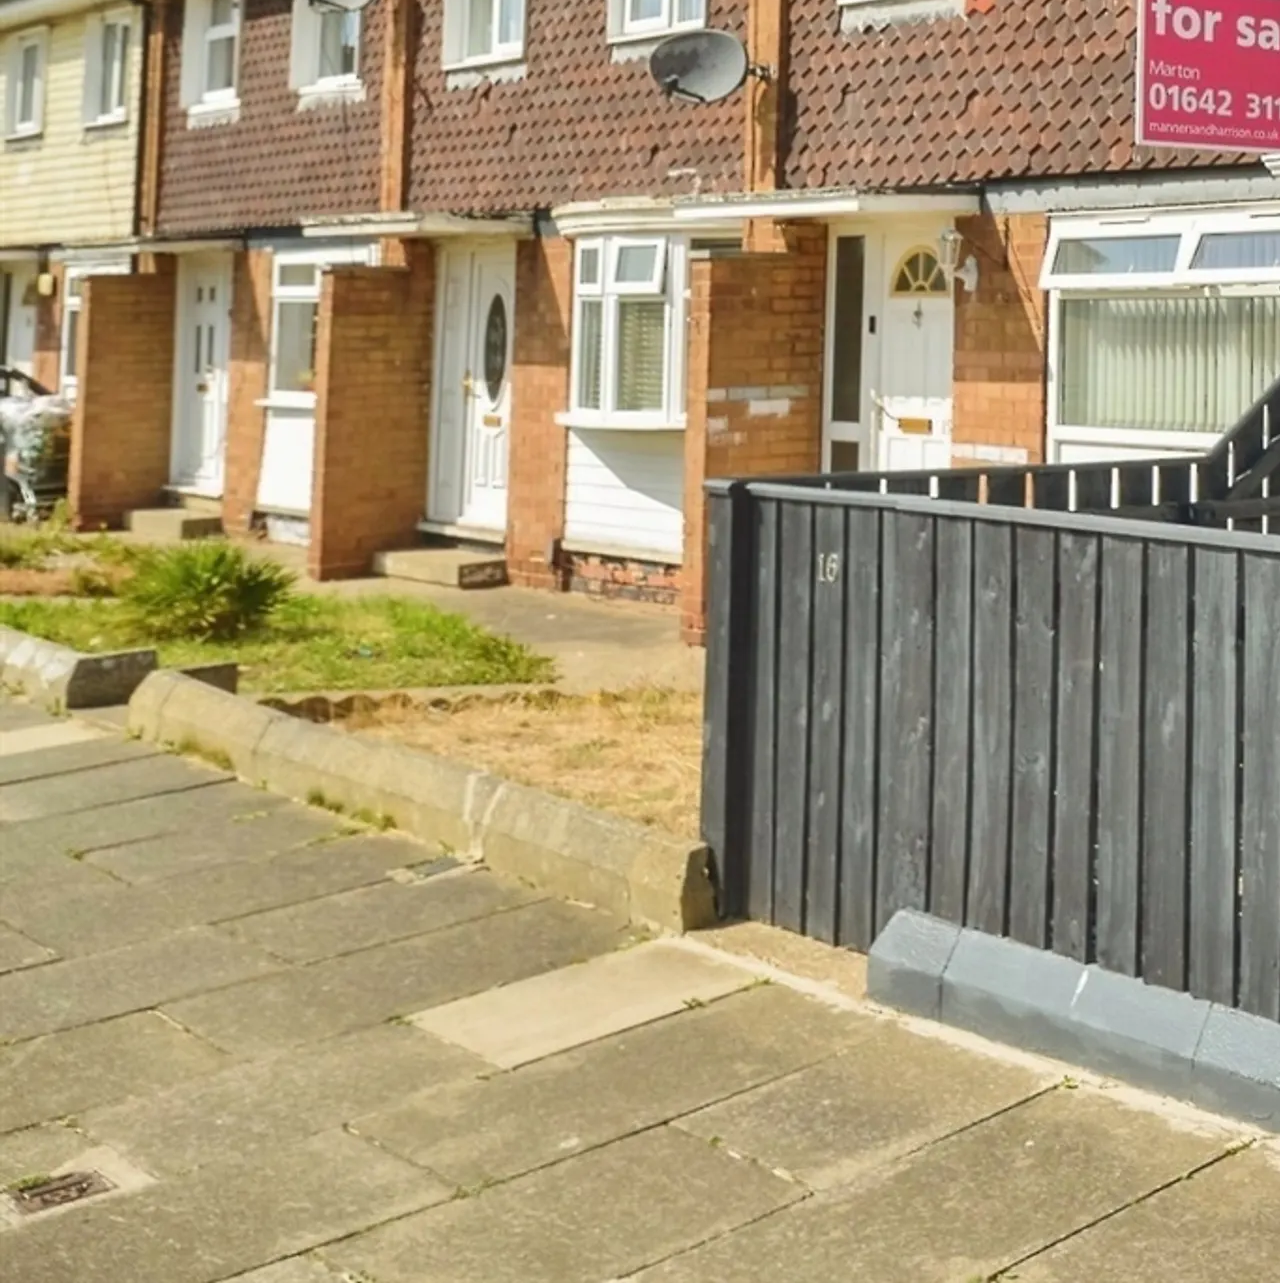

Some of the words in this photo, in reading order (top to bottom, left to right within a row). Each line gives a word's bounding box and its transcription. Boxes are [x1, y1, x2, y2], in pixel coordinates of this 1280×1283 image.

[1149, 60, 1200, 80] Marton
[1149, 83, 1233, 116] 01642
[1149, 122, 1280, 140] mannersandharrison.co.uk
[818, 553, 839, 583] 16
